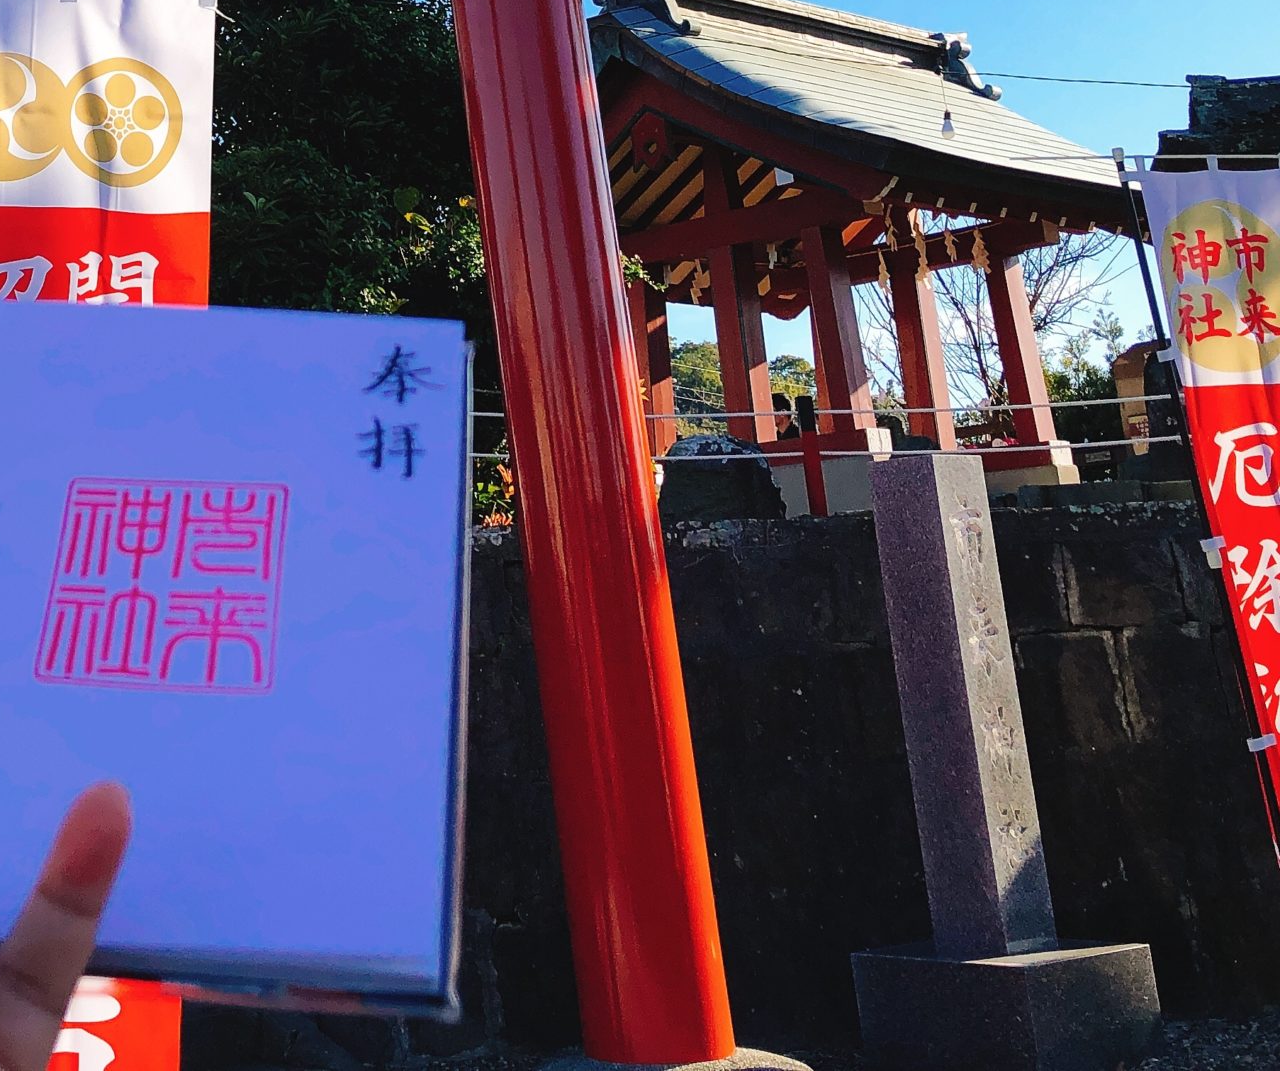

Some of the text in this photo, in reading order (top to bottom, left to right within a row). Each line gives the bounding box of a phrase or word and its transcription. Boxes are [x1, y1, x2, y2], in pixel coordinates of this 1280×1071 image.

[1170, 229, 1233, 346] 神社
[1225, 227, 1280, 344] 市来
[355, 343, 447, 478] 奉拝
